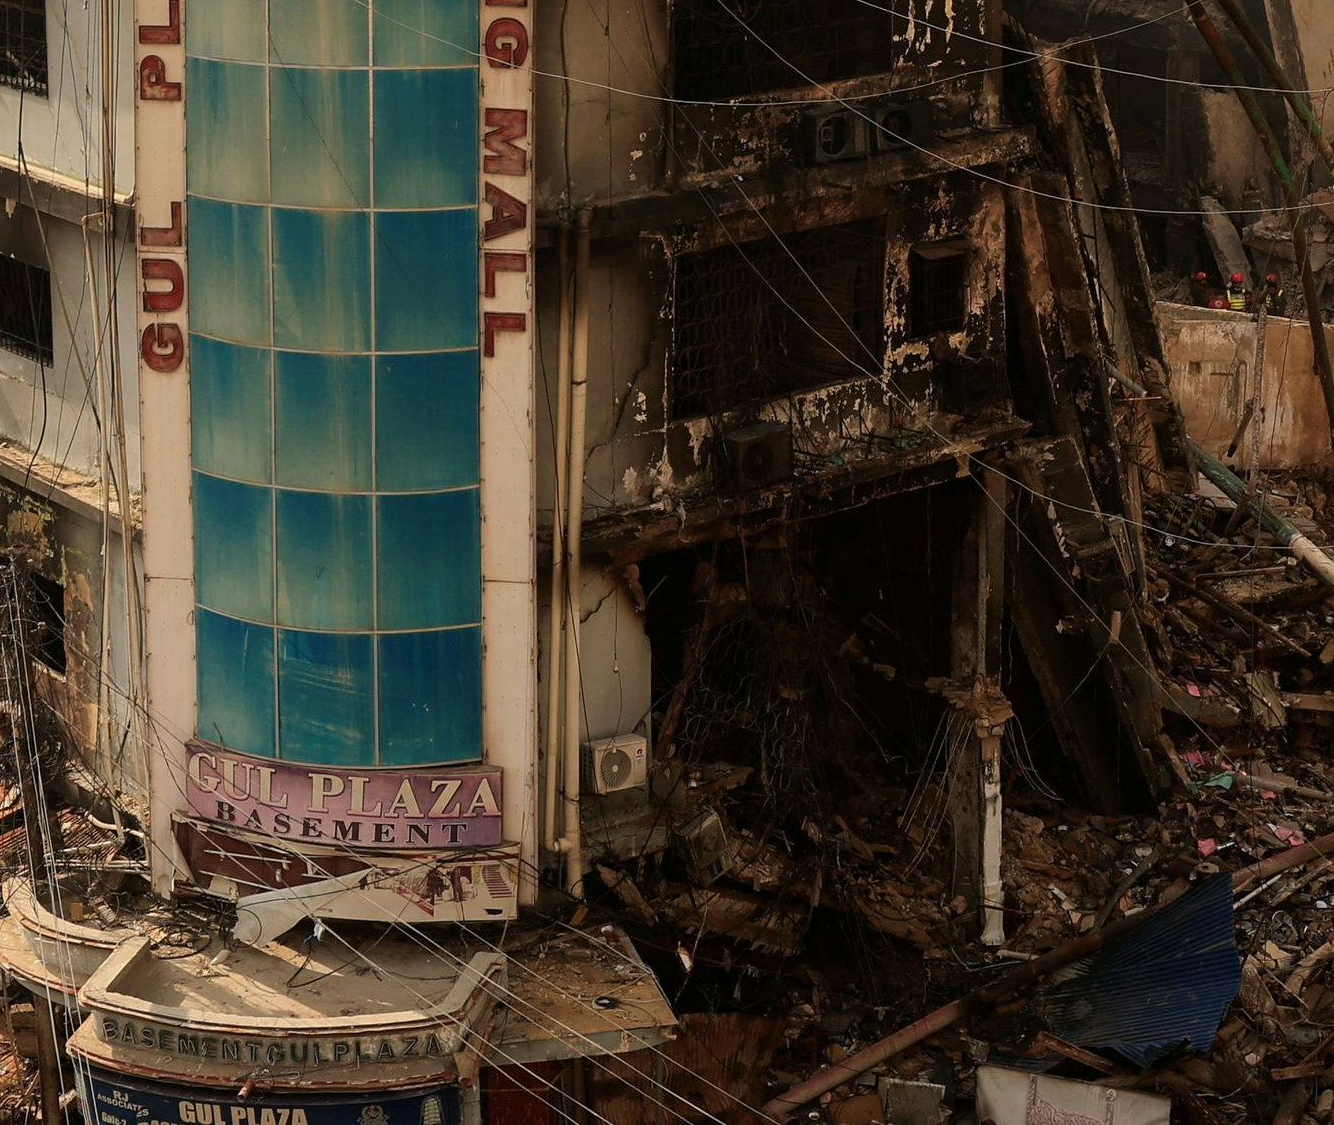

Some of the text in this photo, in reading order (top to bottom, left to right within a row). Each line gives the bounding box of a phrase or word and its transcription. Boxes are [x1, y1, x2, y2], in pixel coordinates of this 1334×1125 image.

[140, 201, 185, 374] GUL
[483, 107, 528, 358] MALL
[187, 752, 502, 819] GUL PLAZA
[216, 799, 467, 844] BASEMENT
[113, 1090, 129, 1102] RJ
[178, 1100, 308, 1125] GUL PLAZA
